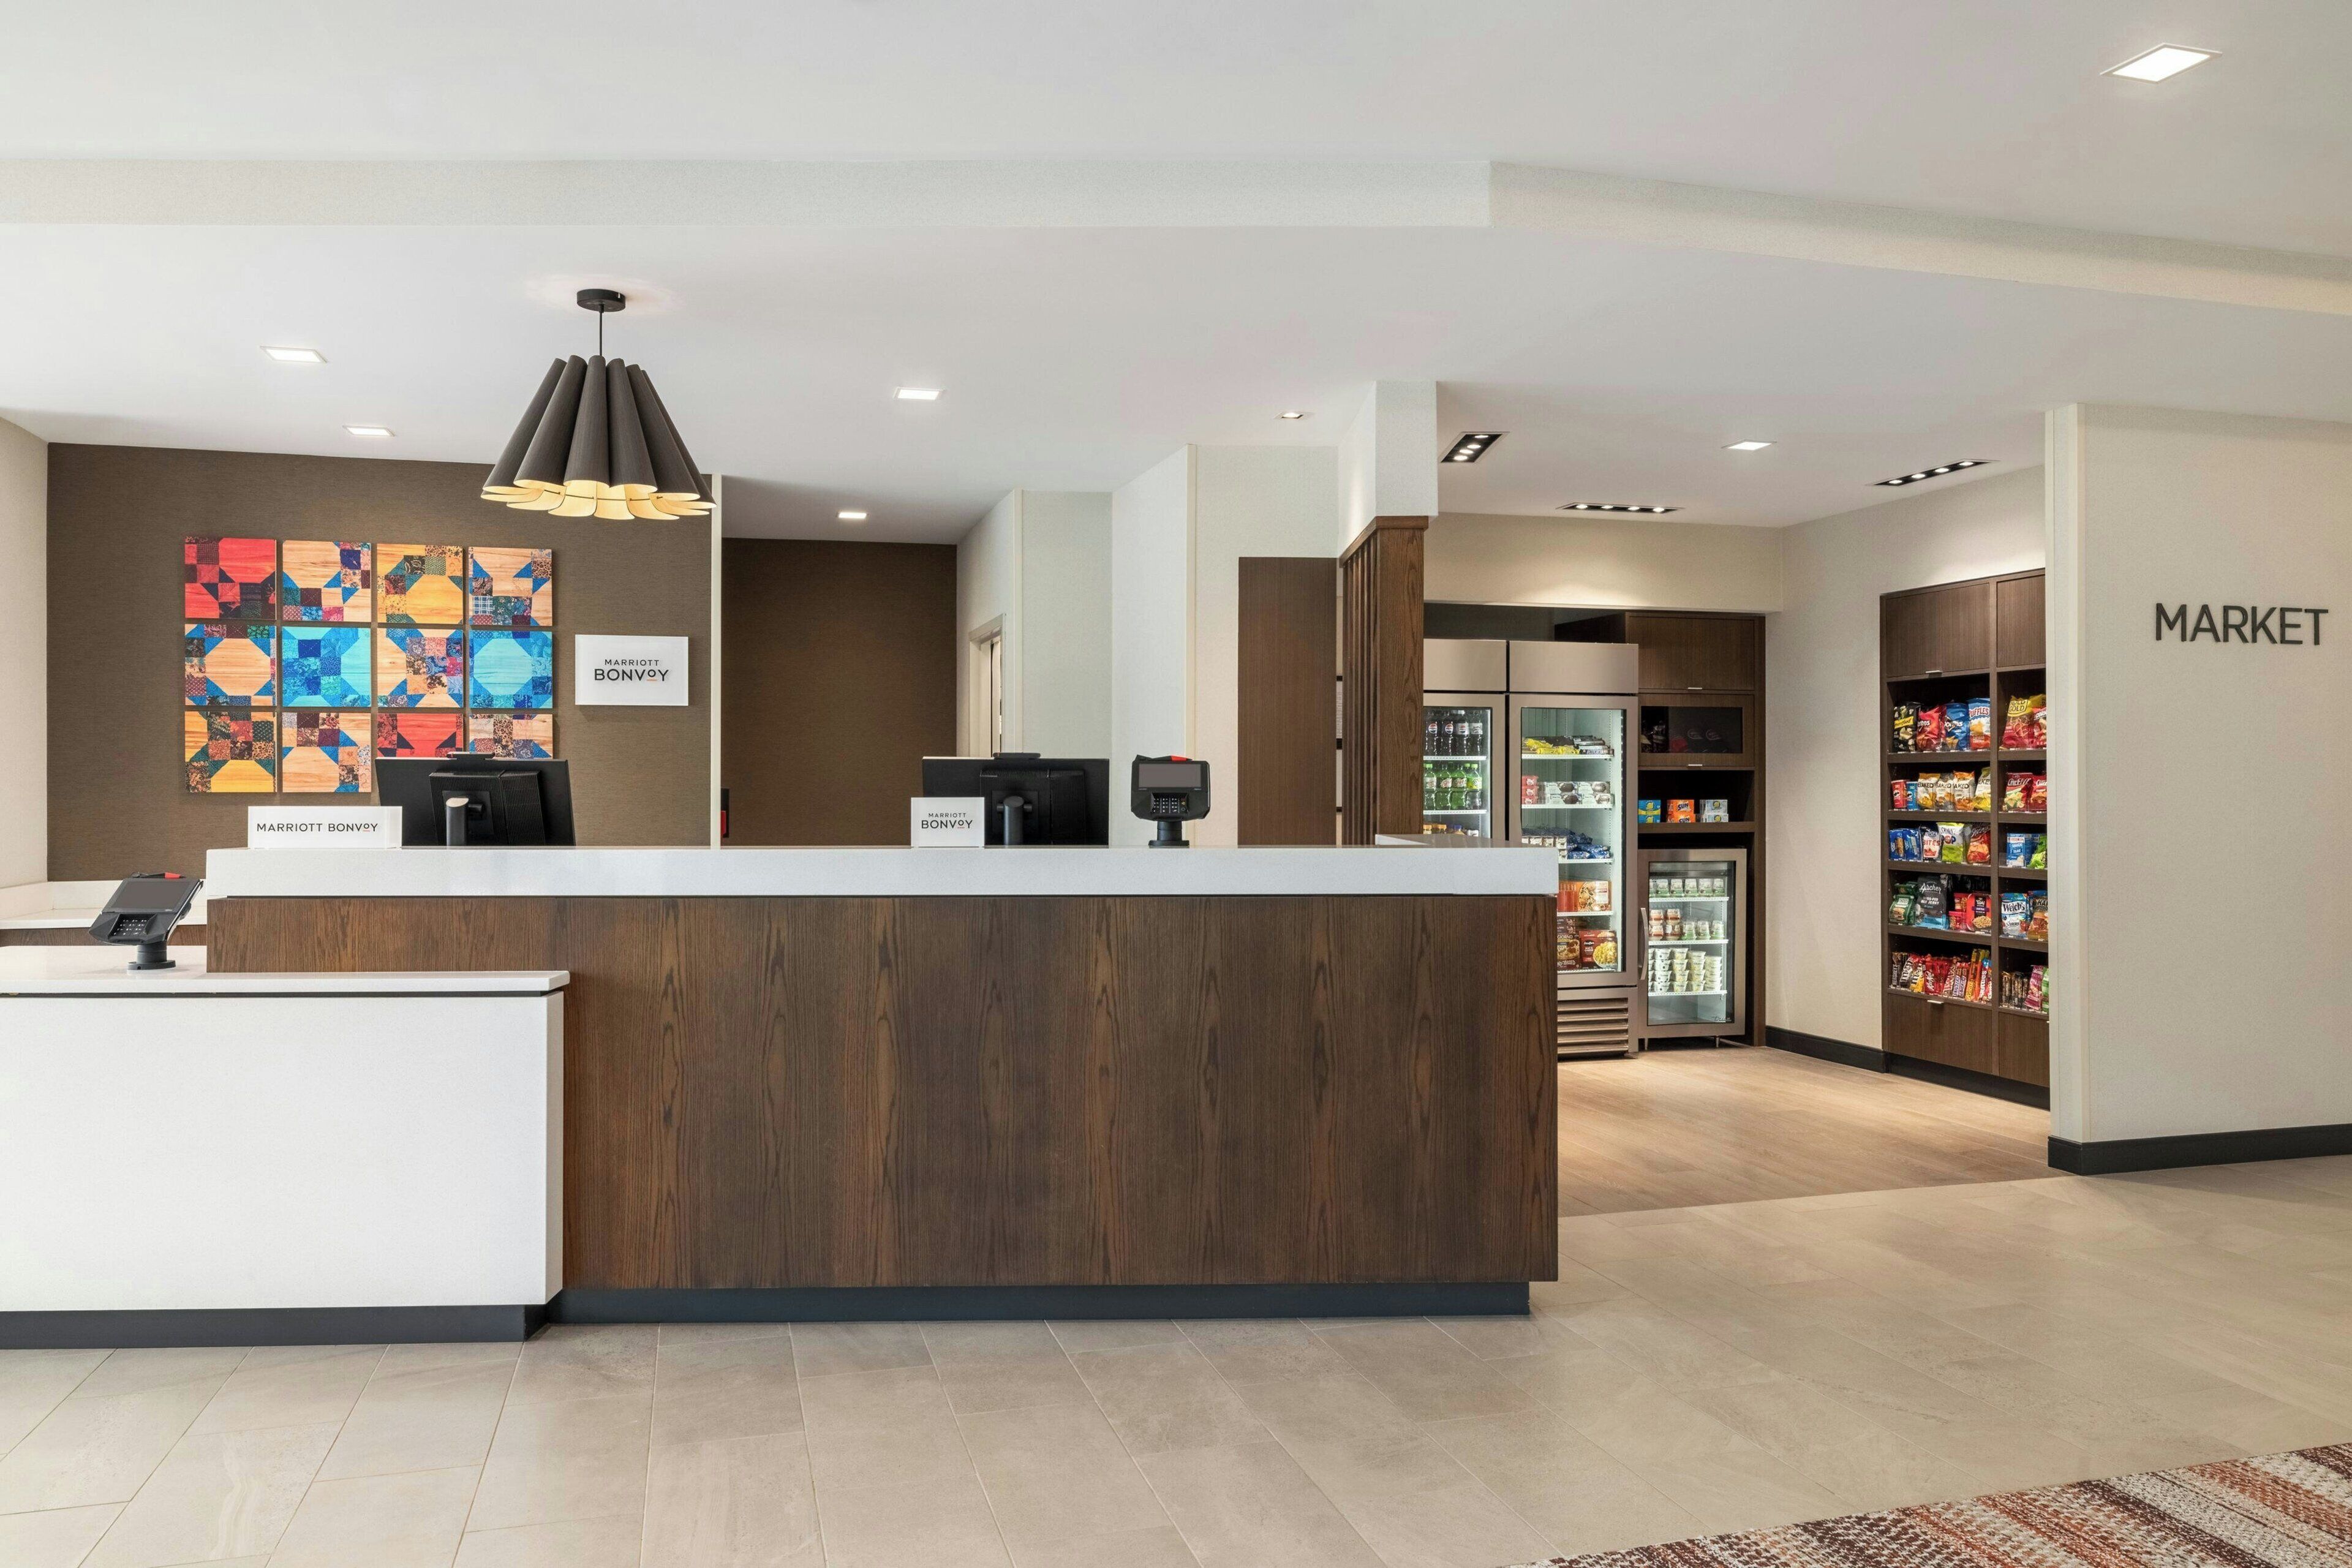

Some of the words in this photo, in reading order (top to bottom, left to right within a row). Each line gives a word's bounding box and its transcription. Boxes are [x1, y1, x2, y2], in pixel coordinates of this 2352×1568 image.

[2155, 603, 2329, 646] MARKET
[594, 669, 669, 681] BONVOY
[257, 823, 323, 832] MARRIOTT
[328, 823, 378, 832] BONVOY
[921, 820, 973, 829] BONVOY
[1919, 883, 1941, 894] Archer
[2002, 902, 2025, 912] Welch's
